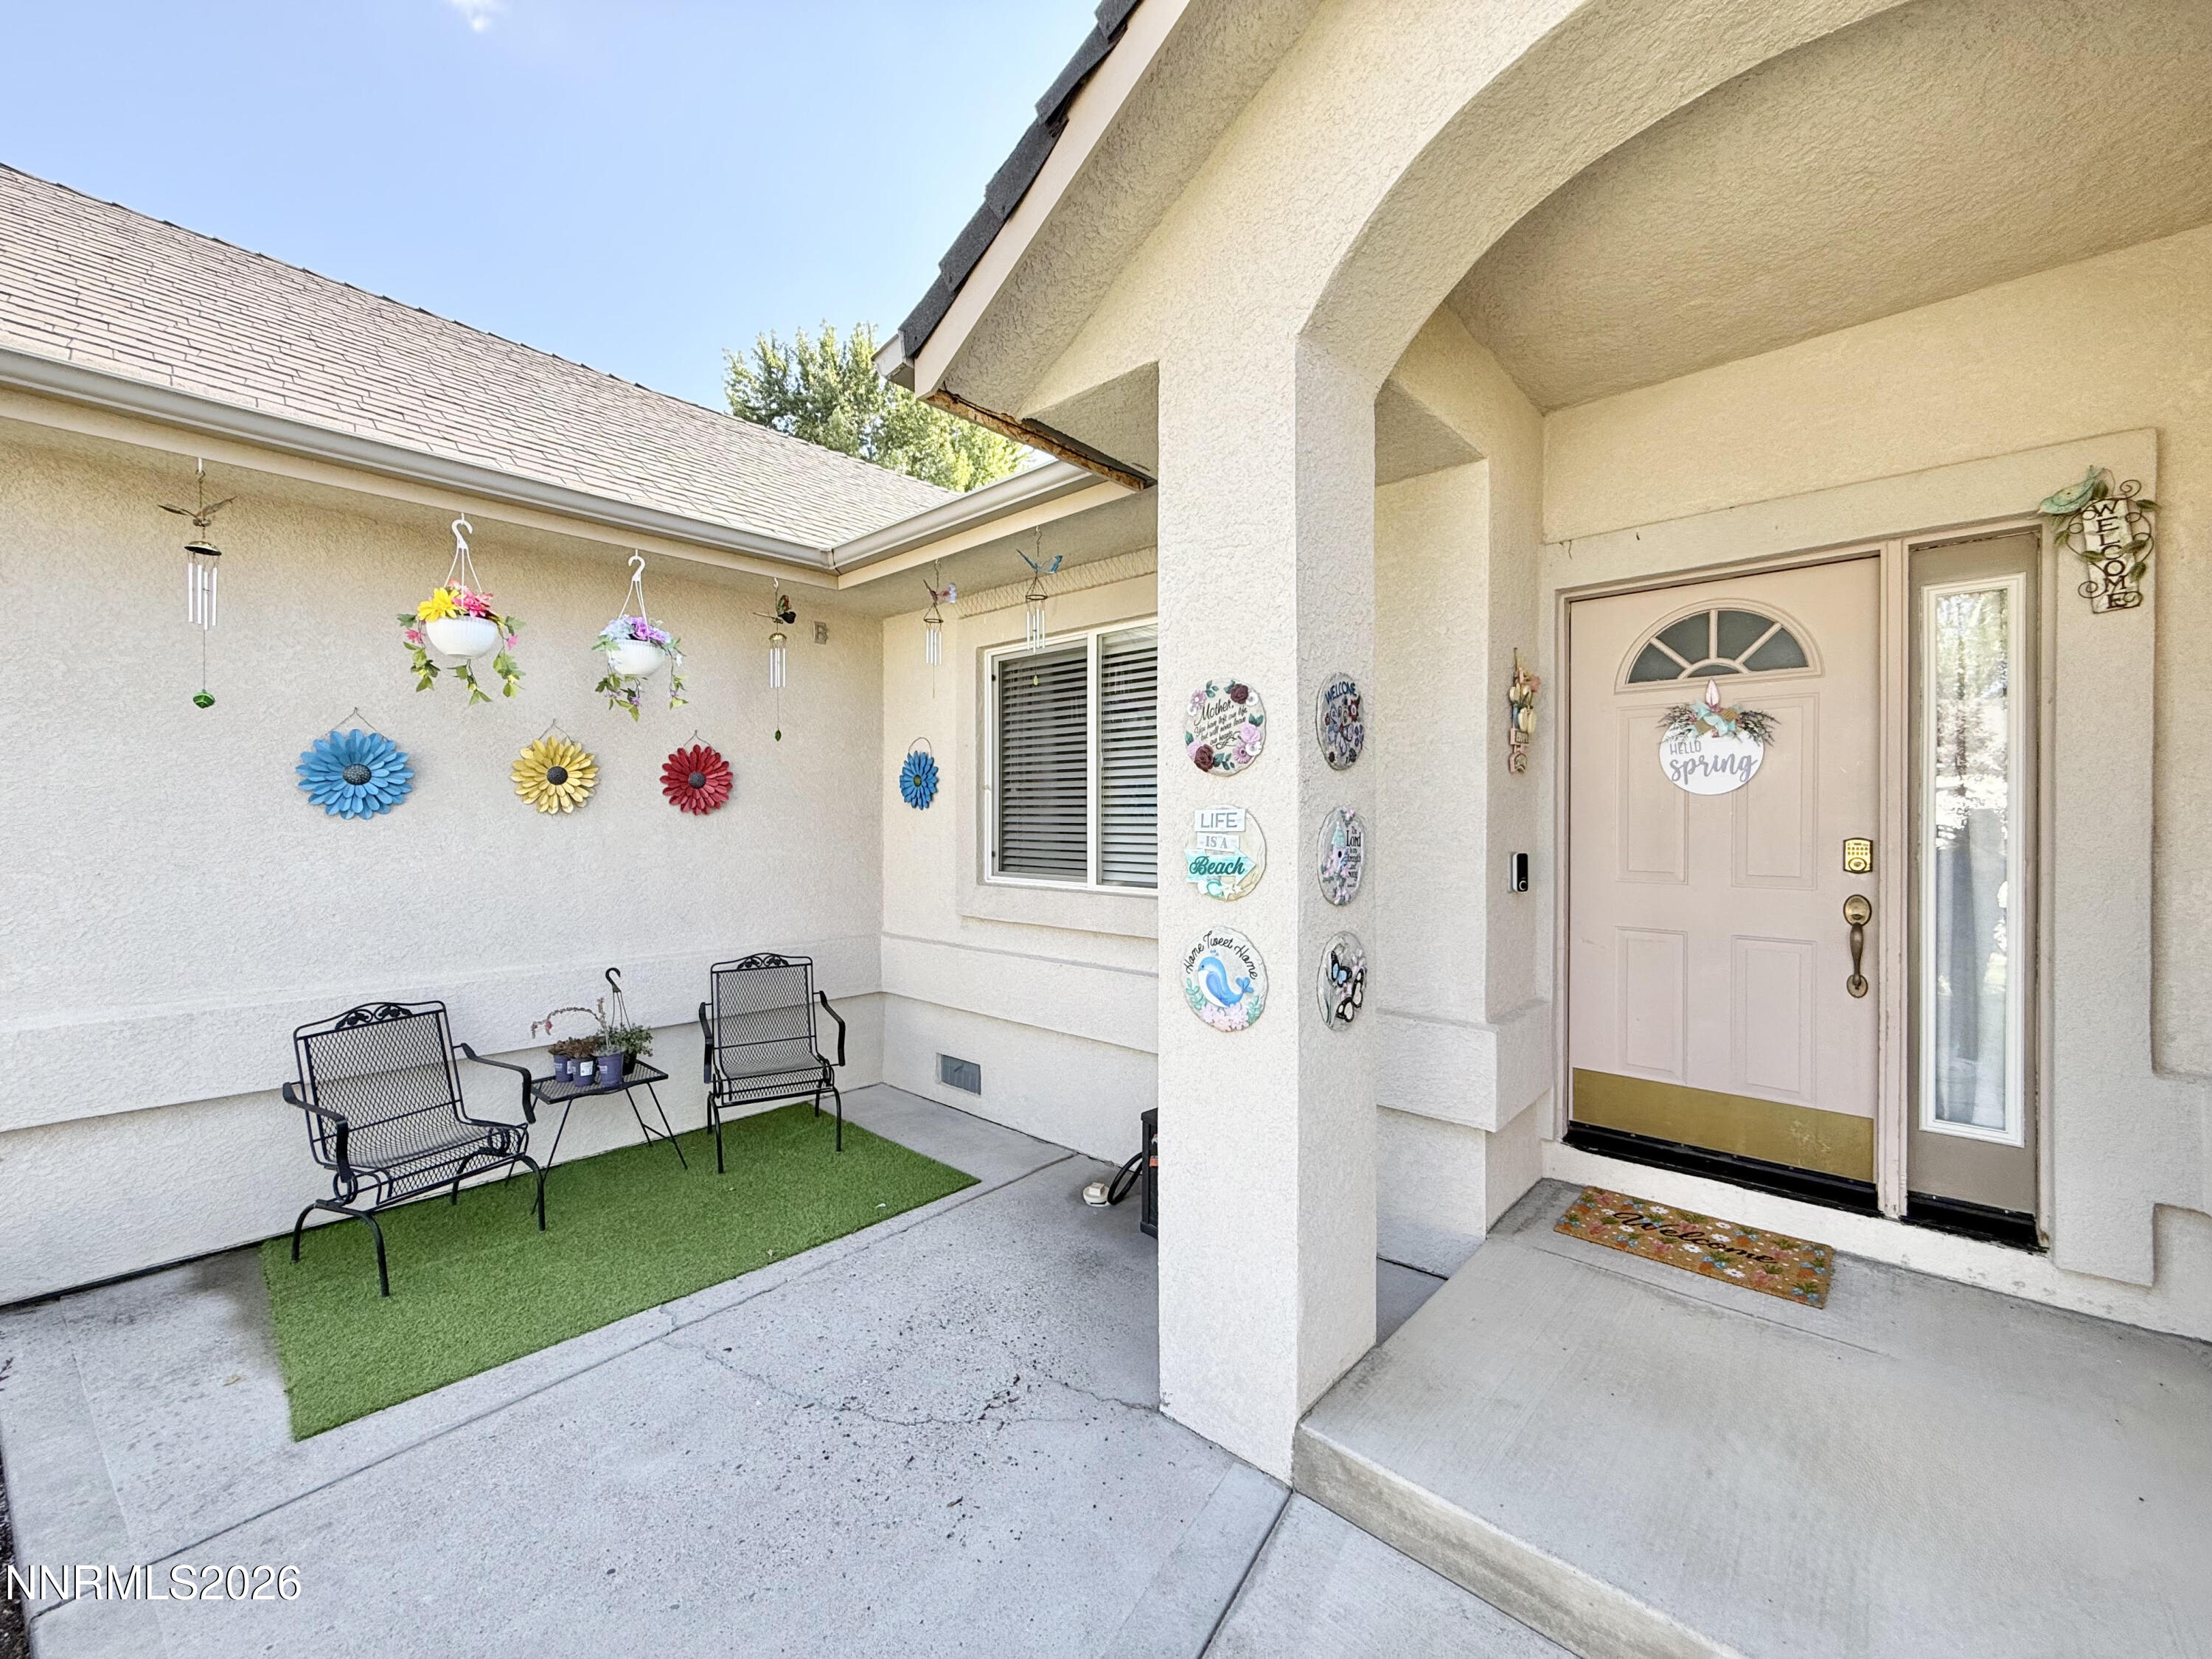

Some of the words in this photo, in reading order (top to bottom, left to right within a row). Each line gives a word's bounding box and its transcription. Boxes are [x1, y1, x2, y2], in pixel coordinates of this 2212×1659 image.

[2090, 498, 2128, 609] WELCOME
[1669, 740, 1702, 755] HELLO
[1669, 754, 1758, 785] spring
[1200, 813, 1237, 828] LIFE
[1206, 835, 1217, 847] IS
[1220, 837, 1228, 849] A
[1346, 830, 1361, 846] Lord
[1189, 856, 1245, 875] Beach
[1183, 943, 1204, 974] Home
[1203, 931, 1234, 949] Tweet
[1234, 945, 1258, 980] Home
[1613, 1212, 1778, 1264] Welcome
